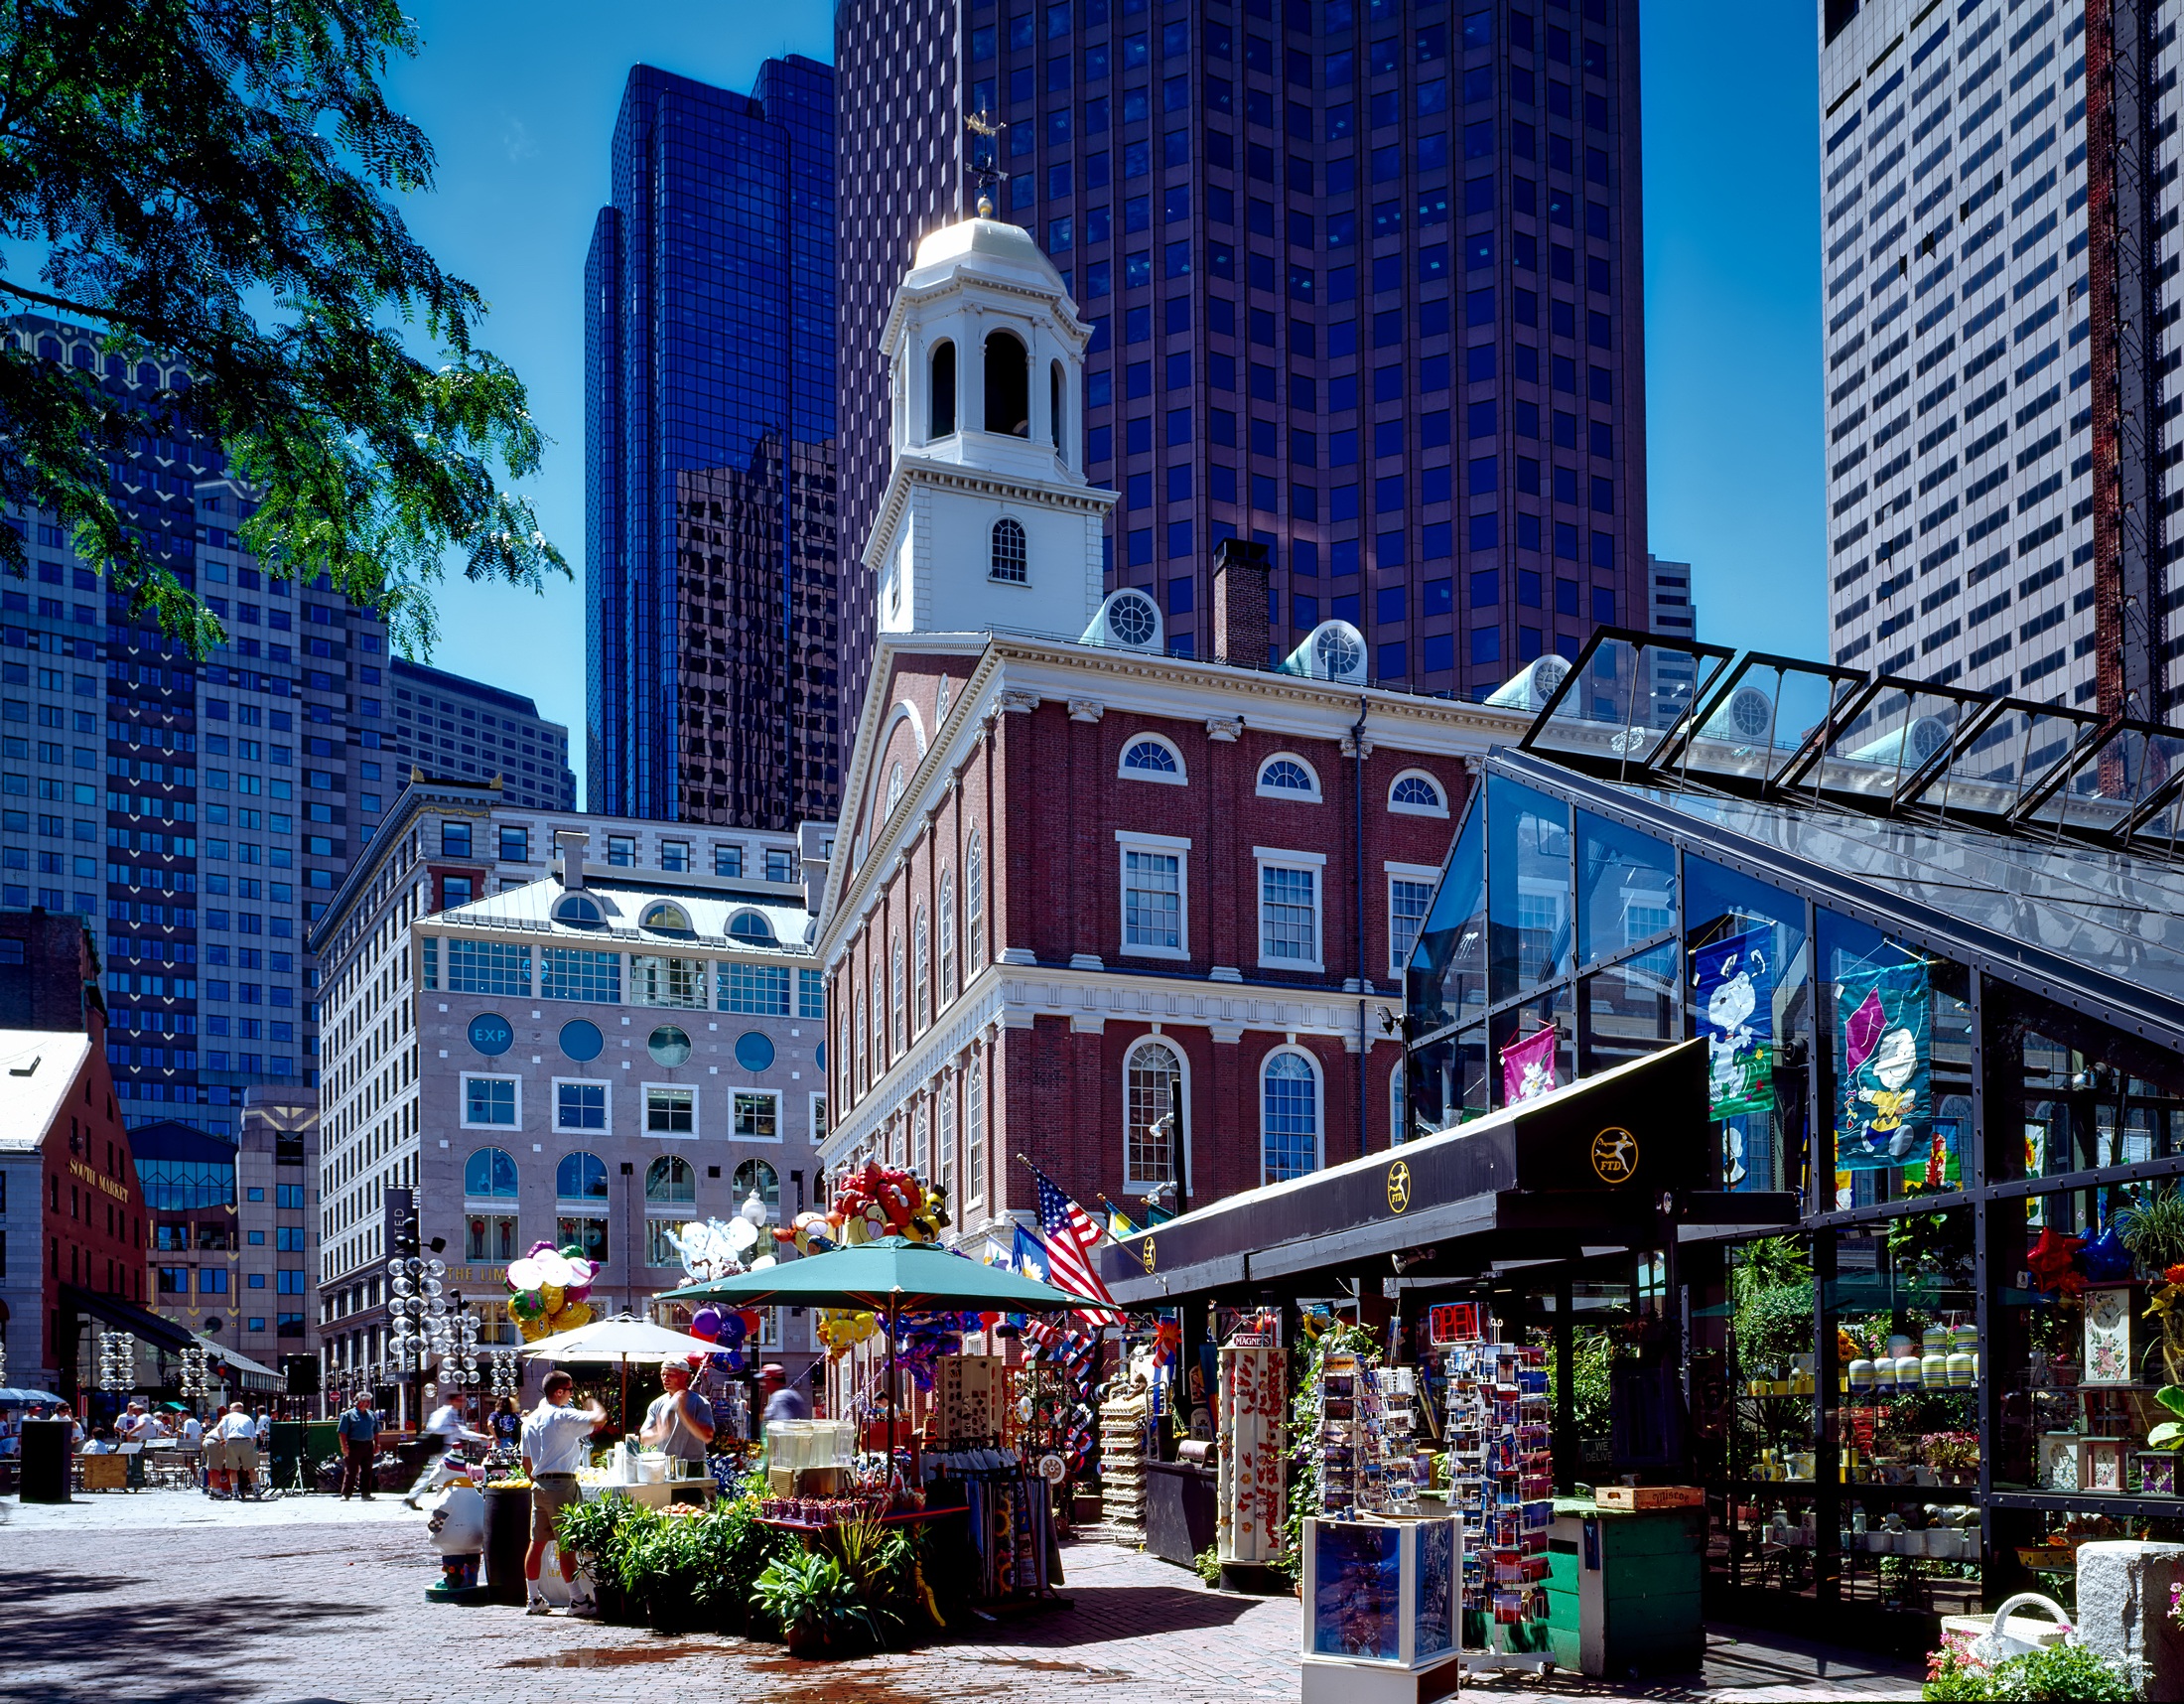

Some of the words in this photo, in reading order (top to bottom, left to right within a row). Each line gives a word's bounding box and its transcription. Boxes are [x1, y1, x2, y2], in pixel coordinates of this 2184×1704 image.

[475, 1029, 507, 1042] EXP
[1600, 1161, 1621, 1171] FTD
[69, 1158, 96, 1187] SOUTH
[98, 1174, 129, 1204] MARKET
[1392, 1192, 1403, 1203] FTD
[447, 1267, 473, 1281] THE
[480, 1268, 505, 1281] LIM
[1432, 1304, 1478, 1344] OPEN
[1235, 1336, 1270, 1347] MAGNES
[1594, 1441, 1609, 1451] WE
[1585, 1451, 1613, 1463] DELIVE
[1383, 1561, 1395, 1626] BOSTON
